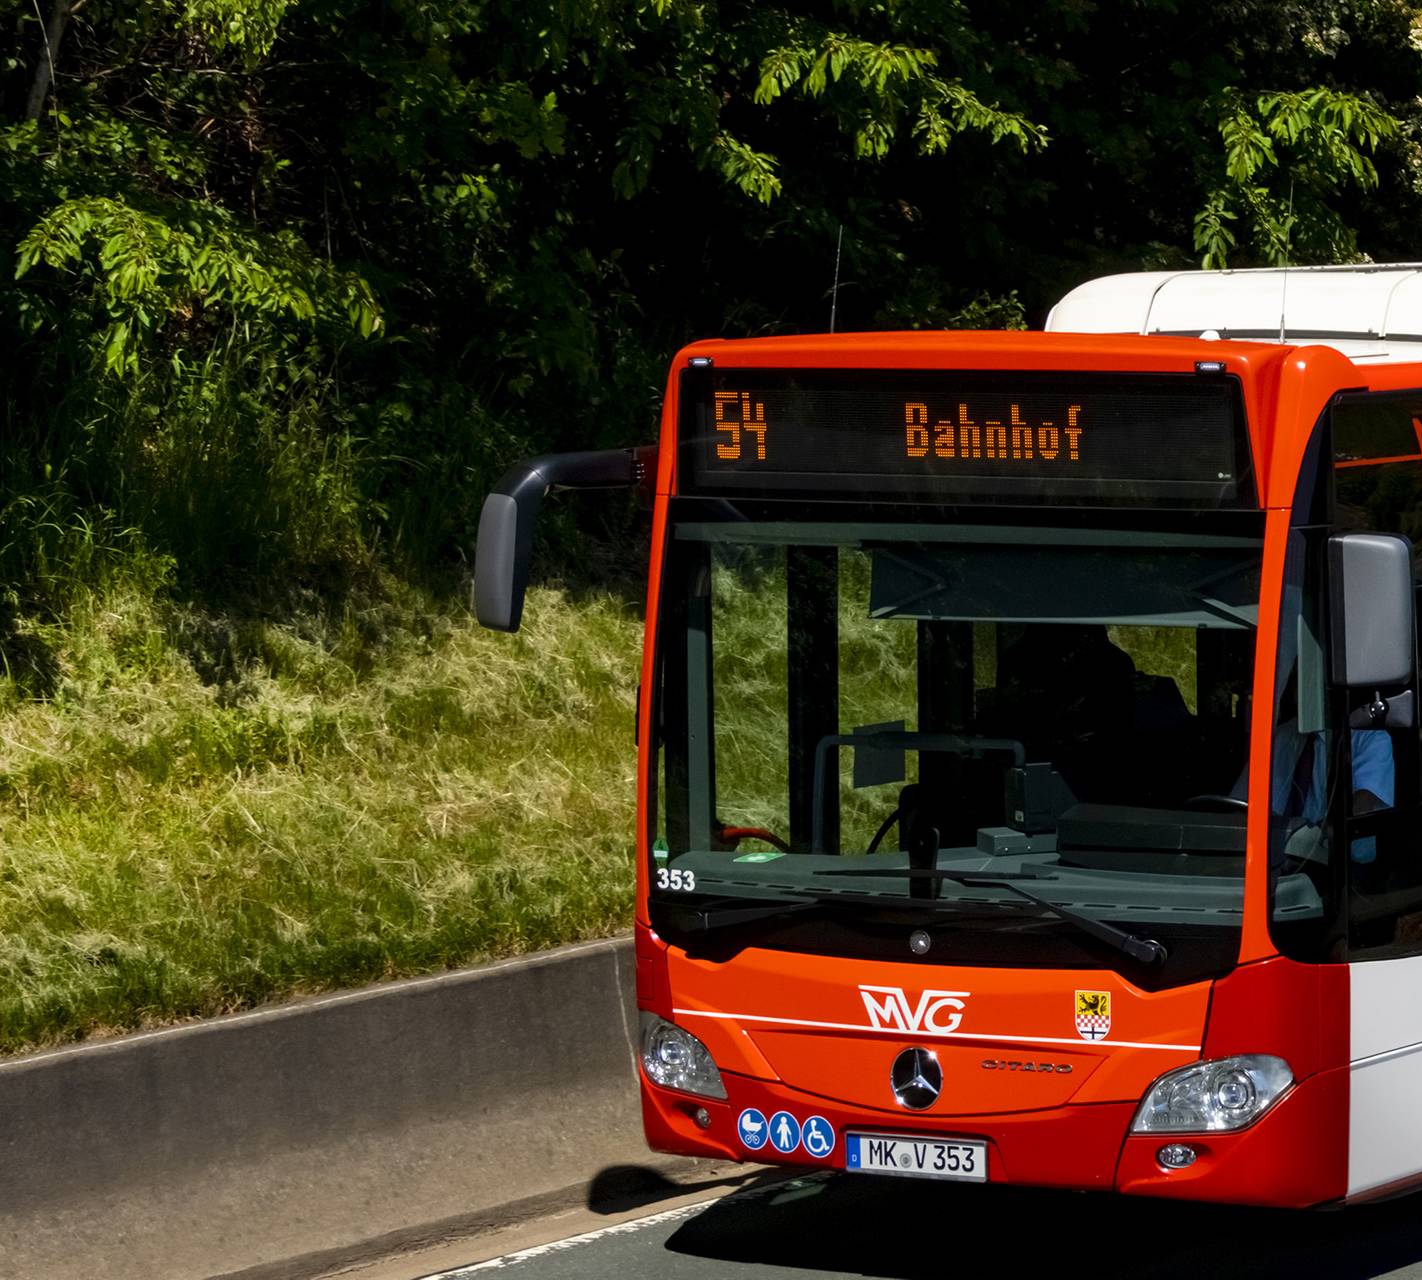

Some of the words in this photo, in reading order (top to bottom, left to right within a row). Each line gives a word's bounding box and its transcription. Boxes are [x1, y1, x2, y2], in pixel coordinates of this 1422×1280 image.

[714, 391, 768, 460] 54
[905, 402, 1083, 461] Bahnhof
[657, 867, 696, 892] 353
[857, 984, 972, 1034] MVG
[981, 1059, 1073, 1075] CITARO
[868, 1138, 898, 1168] MK
[913, 1142, 928, 1170] V
[932, 1144, 976, 1173] 353
